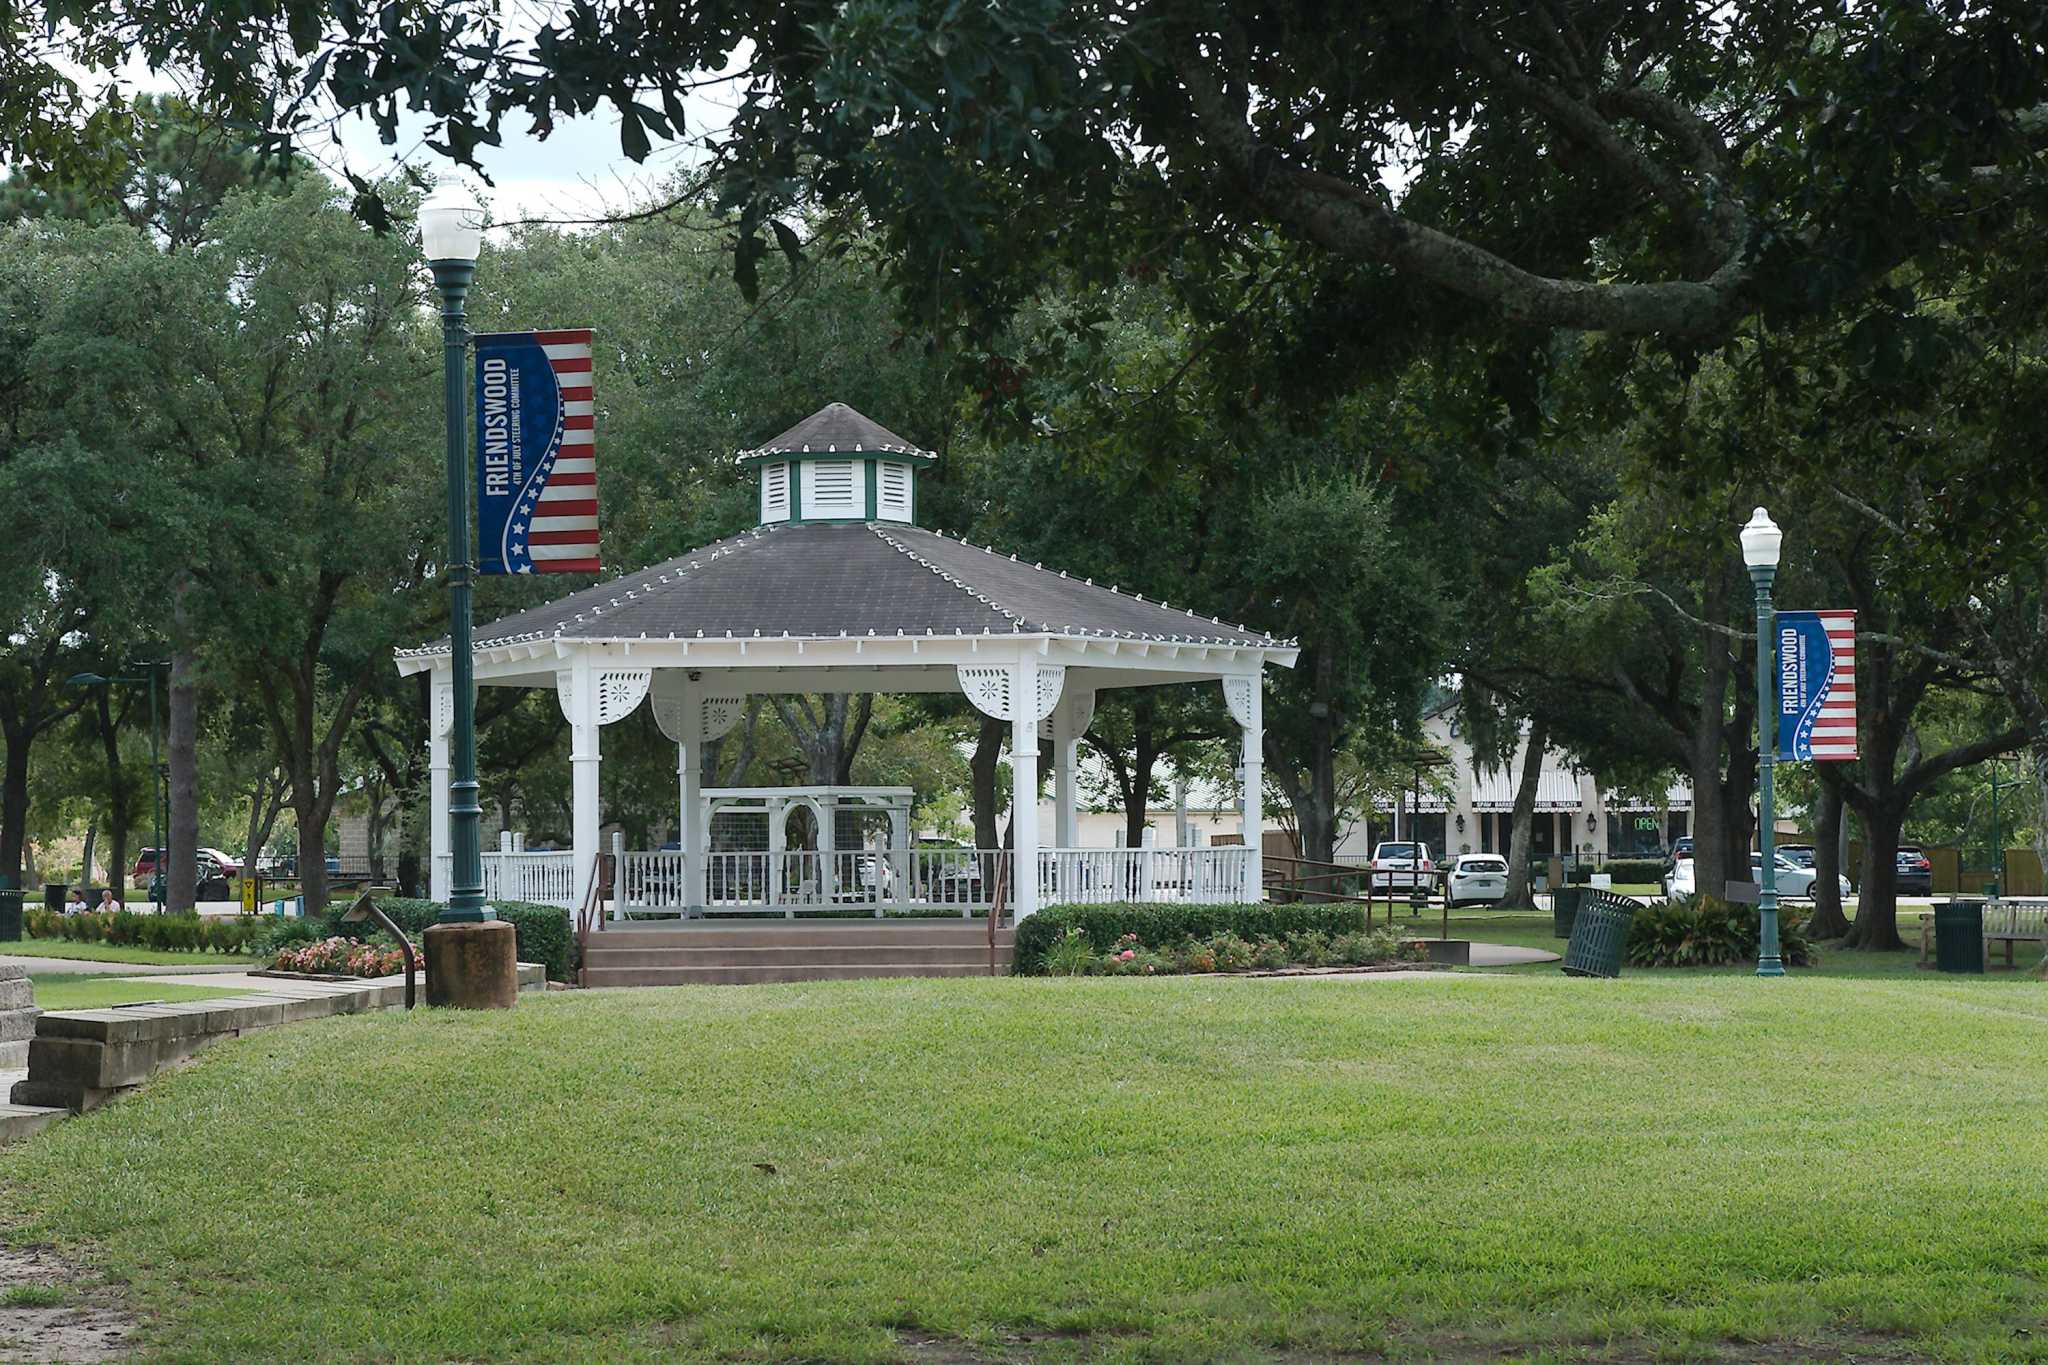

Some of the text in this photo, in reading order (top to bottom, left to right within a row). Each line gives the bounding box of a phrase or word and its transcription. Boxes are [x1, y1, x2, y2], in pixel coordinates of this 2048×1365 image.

[483, 359, 509, 496] FRIENDSWOOD
[510, 368, 523, 485] 4TH OF JULY STEERING COMMITTEE
[1782, 628, 1798, 714] FRIENDSWOOD
[1634, 816, 1659, 831] OPEN
